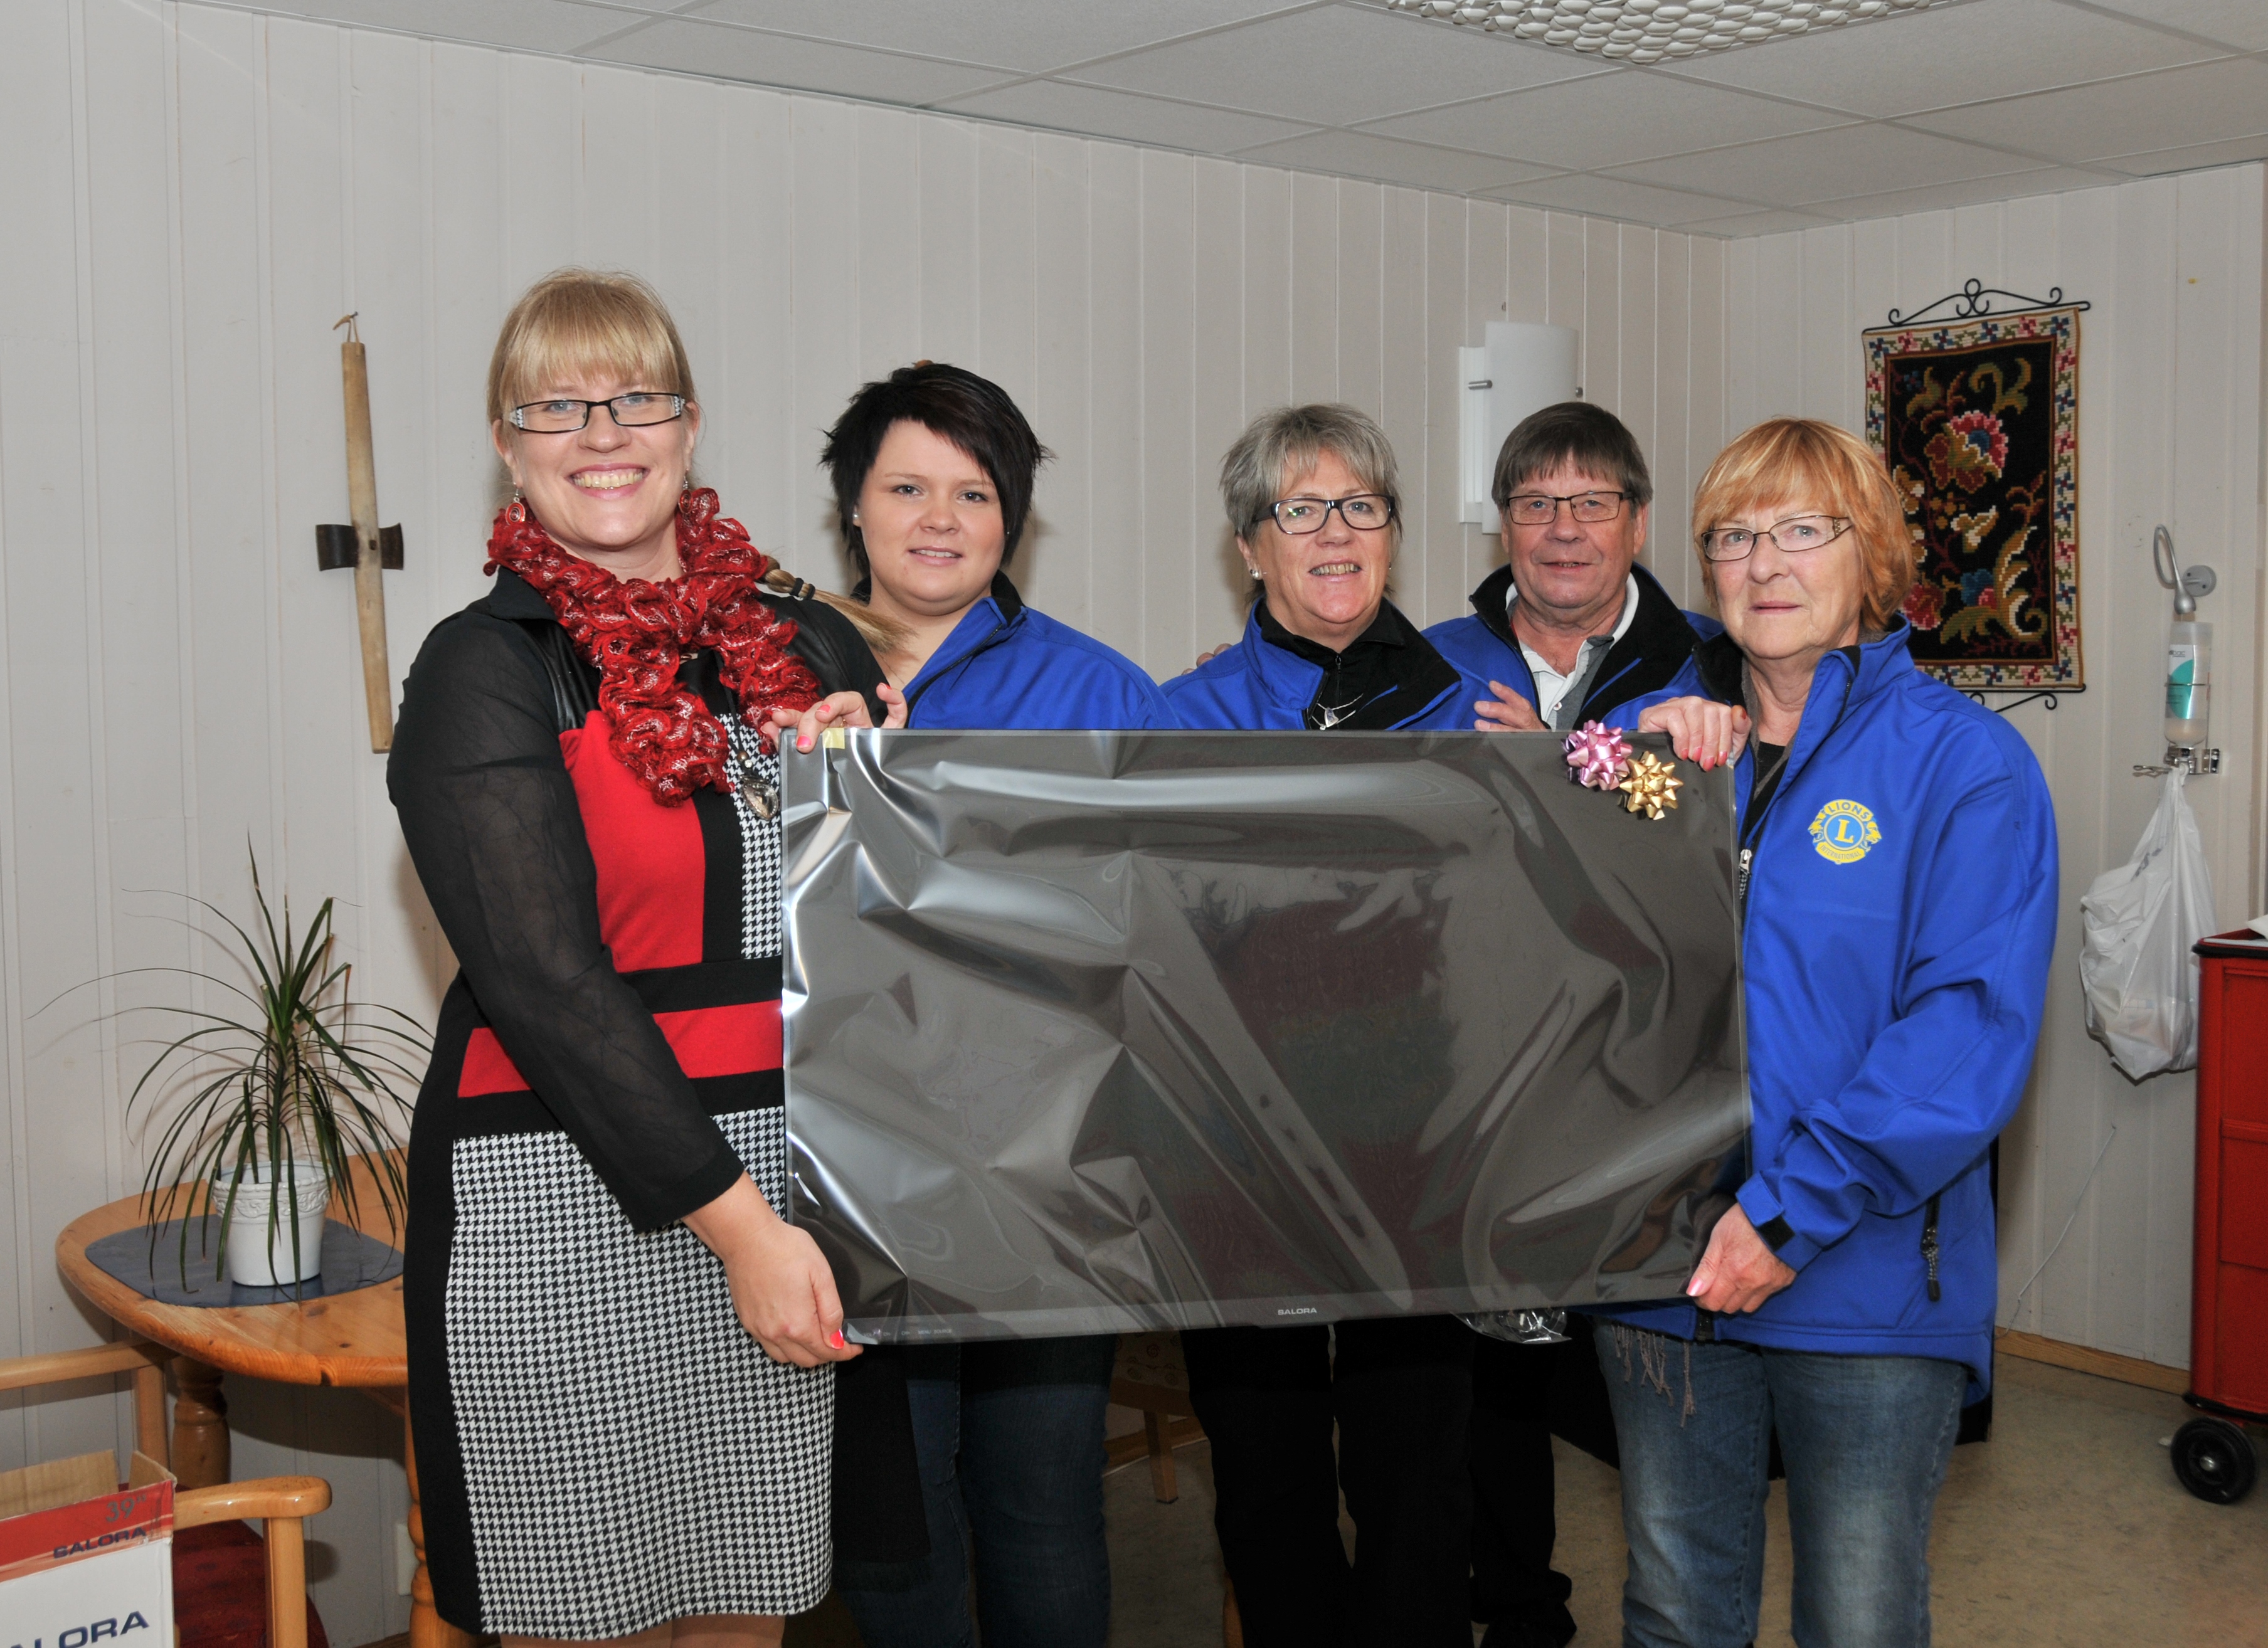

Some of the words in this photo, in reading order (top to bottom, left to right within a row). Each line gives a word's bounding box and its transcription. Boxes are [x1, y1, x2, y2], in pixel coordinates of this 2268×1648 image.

[1827, 802, 1870, 820] LIONS
[1835, 818, 1854, 843] L
[1819, 845, 1862, 860] INTERNATIONAL
[106, 1494, 147, 1523] 39"
[53, 1526, 147, 1559] SALORA
